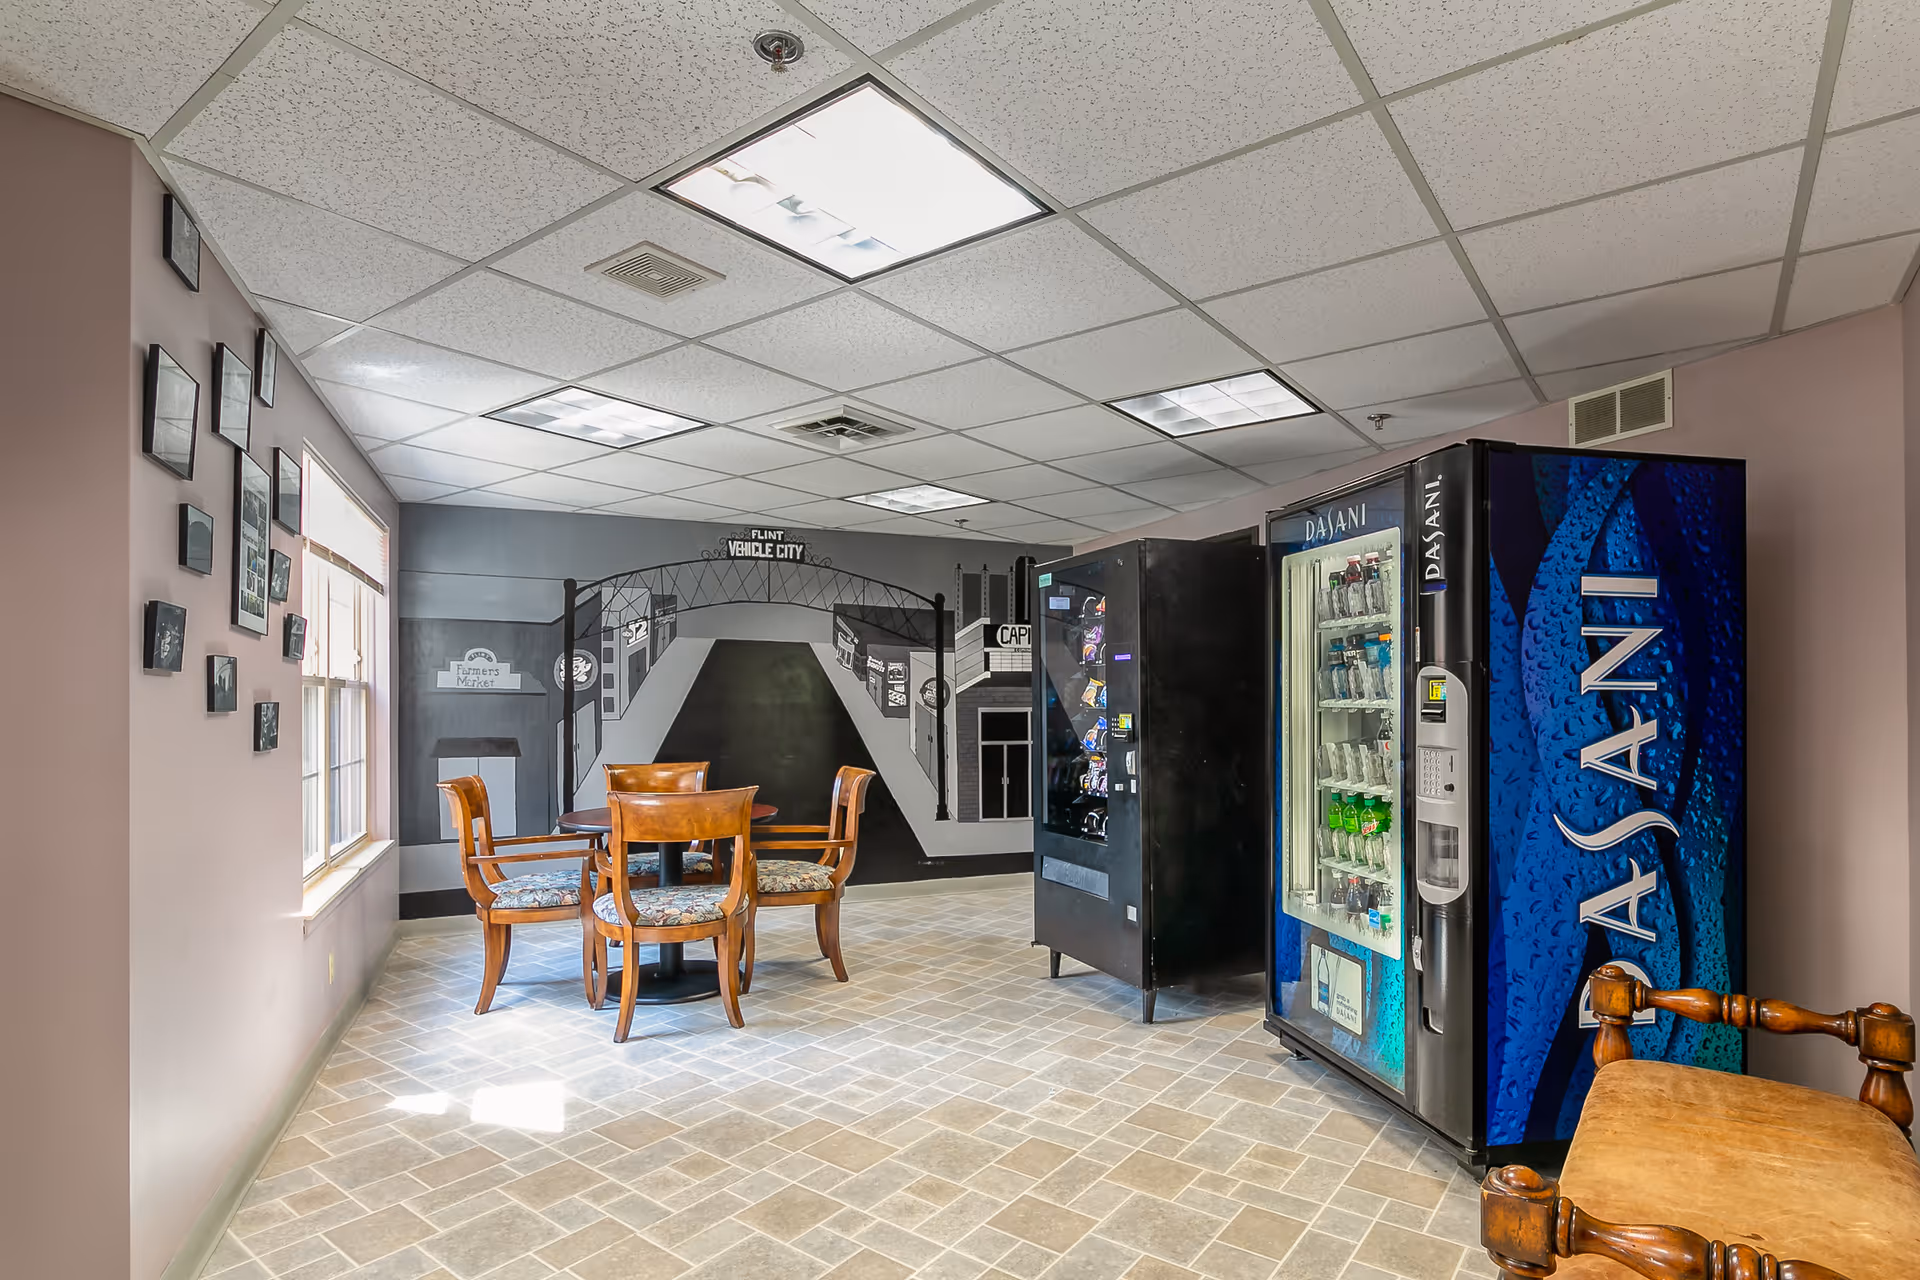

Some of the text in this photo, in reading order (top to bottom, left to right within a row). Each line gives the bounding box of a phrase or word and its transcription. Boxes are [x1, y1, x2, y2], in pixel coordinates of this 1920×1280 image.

[1305, 503, 1366, 541] DASANI
[1422, 478, 1446, 581] DASANI
[751, 529, 784, 541] FLINT
[728, 540, 804, 559] VEHICLE CITY
[1000, 625, 1031, 646] CAPI
[456, 676, 495, 688] Market
[1336, 1006, 1357, 1024] DASANI
